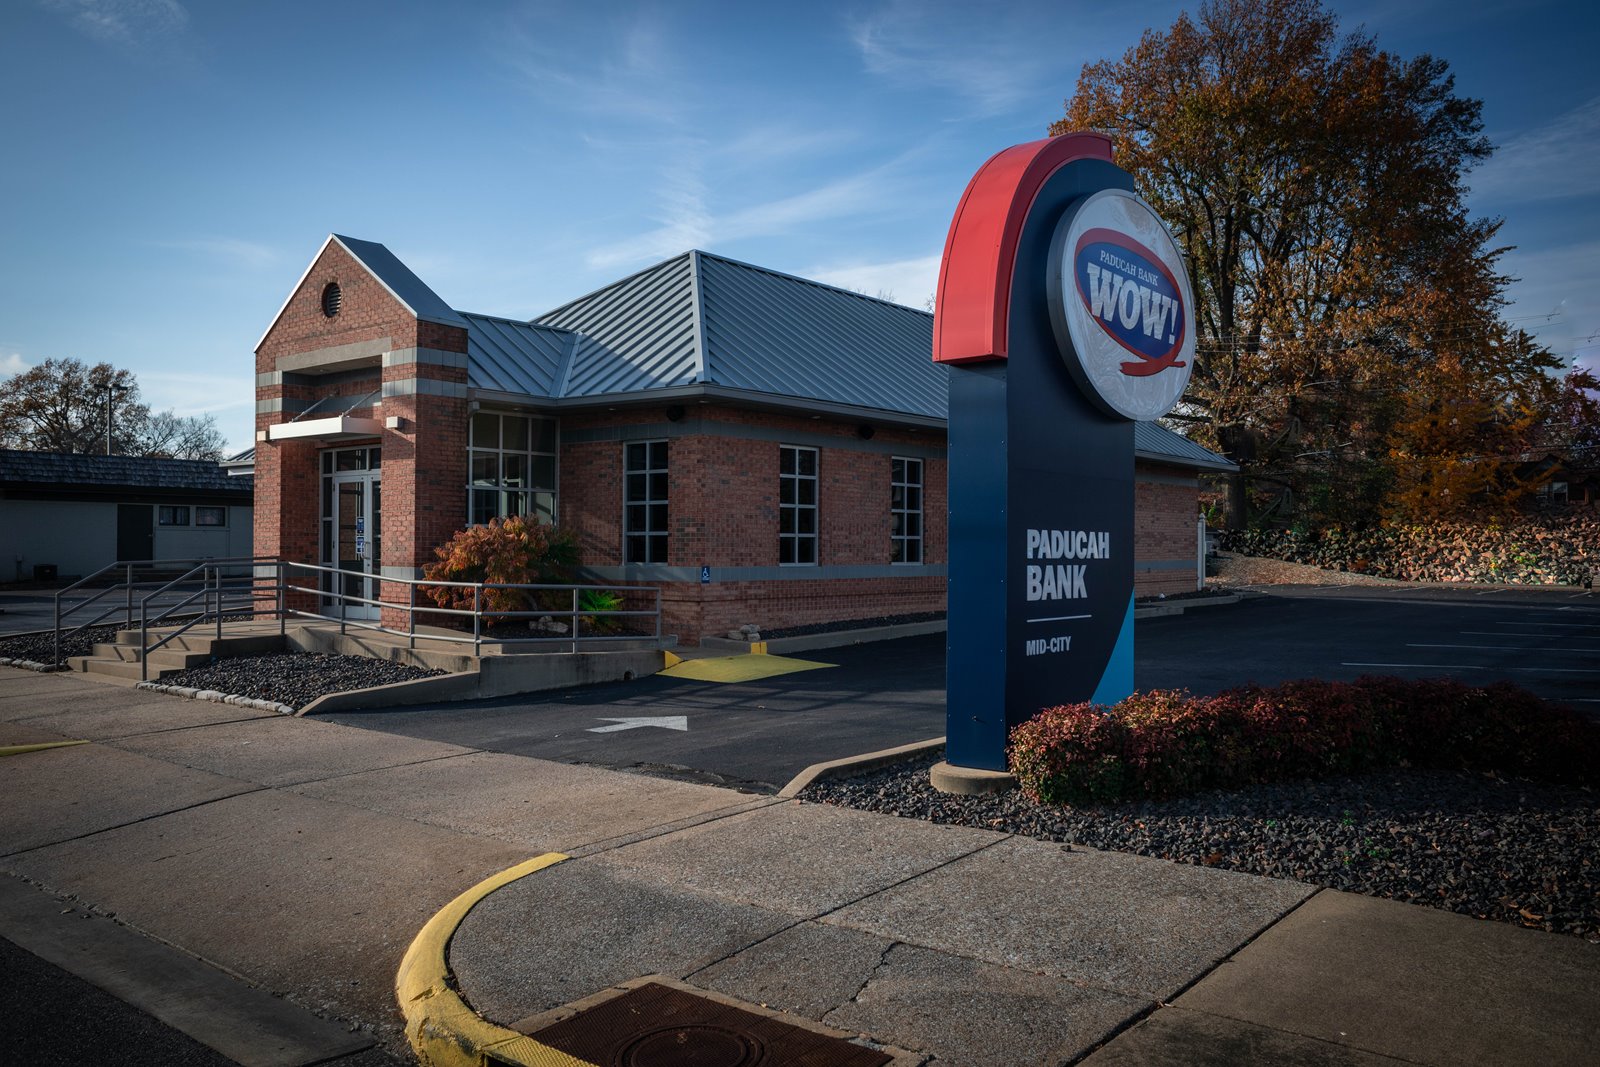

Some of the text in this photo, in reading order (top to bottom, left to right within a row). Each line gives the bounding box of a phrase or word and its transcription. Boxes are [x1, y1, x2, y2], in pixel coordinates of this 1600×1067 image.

[1100, 250, 1159, 287] PADUCAH BANK
[1087, 262, 1179, 345] WOW!
[1026, 528, 1110, 559] PADUCAH
[1026, 564, 1088, 601] BANK
[1026, 636, 1072, 656] MID-CITY
